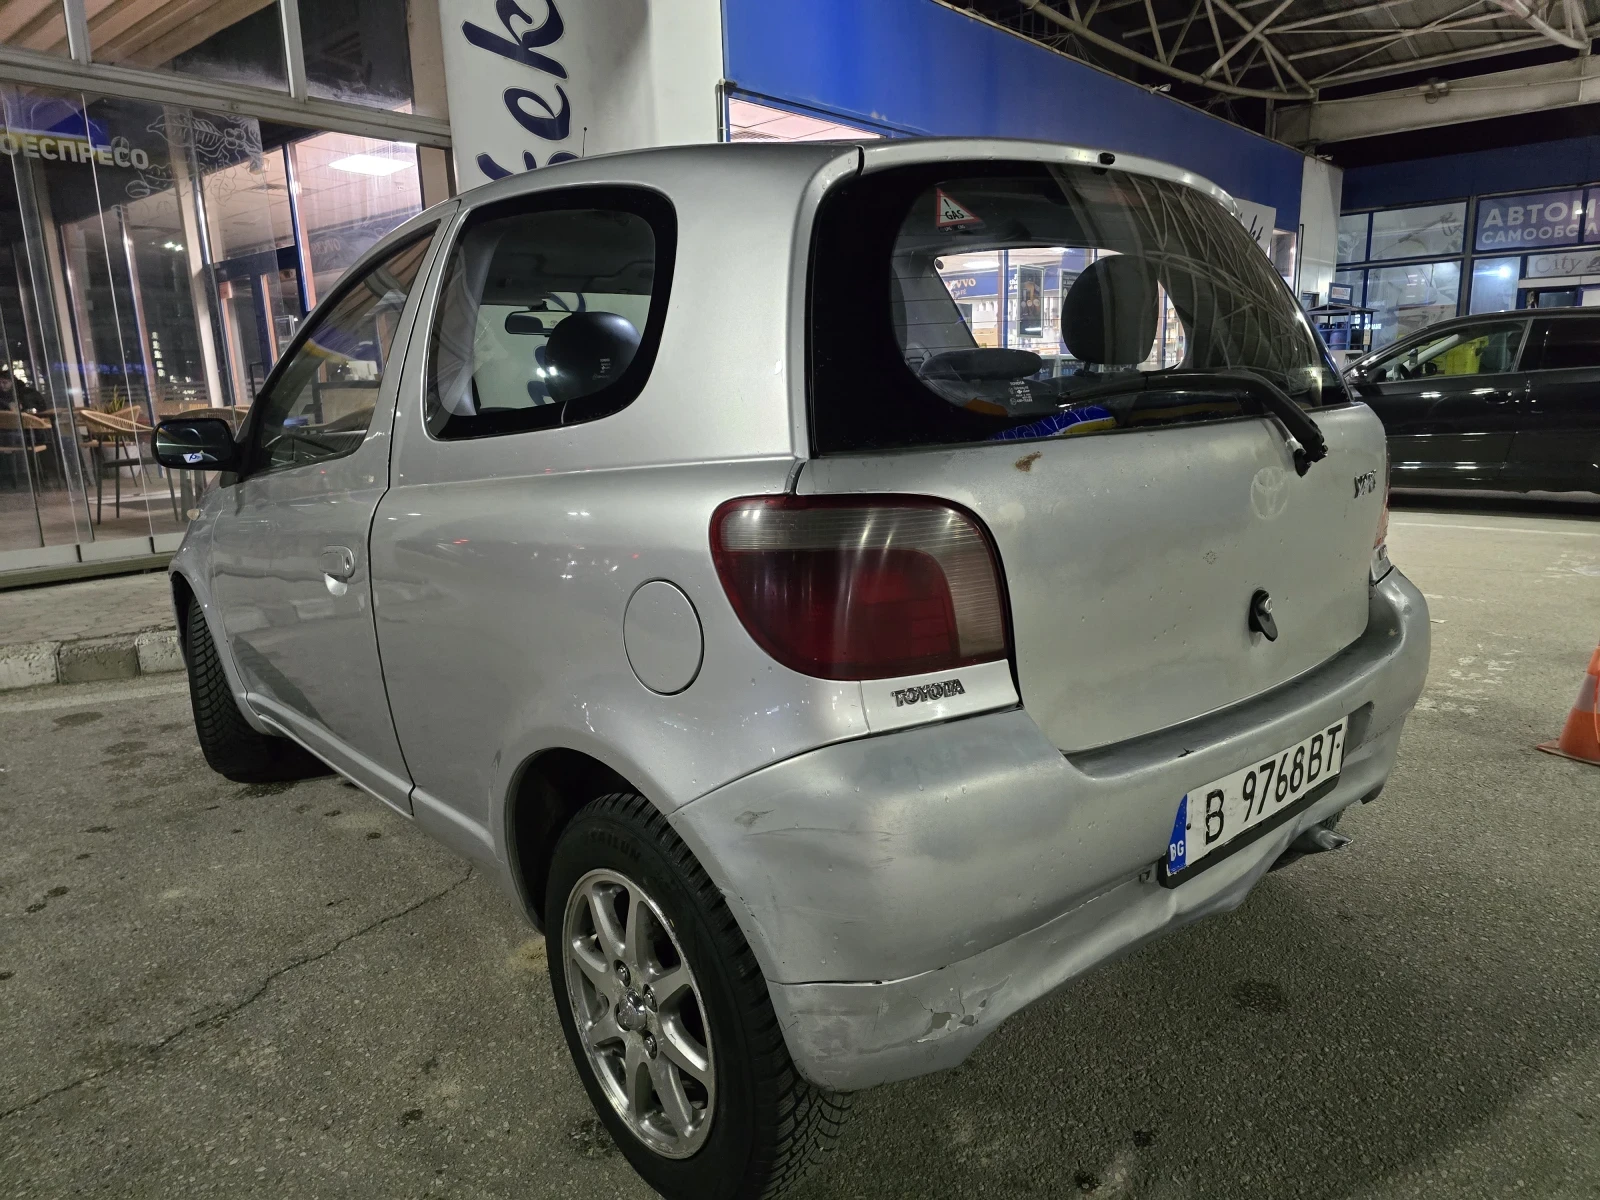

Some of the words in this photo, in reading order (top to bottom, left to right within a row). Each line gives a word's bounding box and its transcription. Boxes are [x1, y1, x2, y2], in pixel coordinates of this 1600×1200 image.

[945, 209, 965, 220] GAS
[1535, 254, 1583, 273] City
[891, 679, 966, 707] TOYOTA
[1206, 788, 1225, 845] B
[1243, 723, 1342, 823] 9768BT
[1169, 840, 1184, 862] BG
